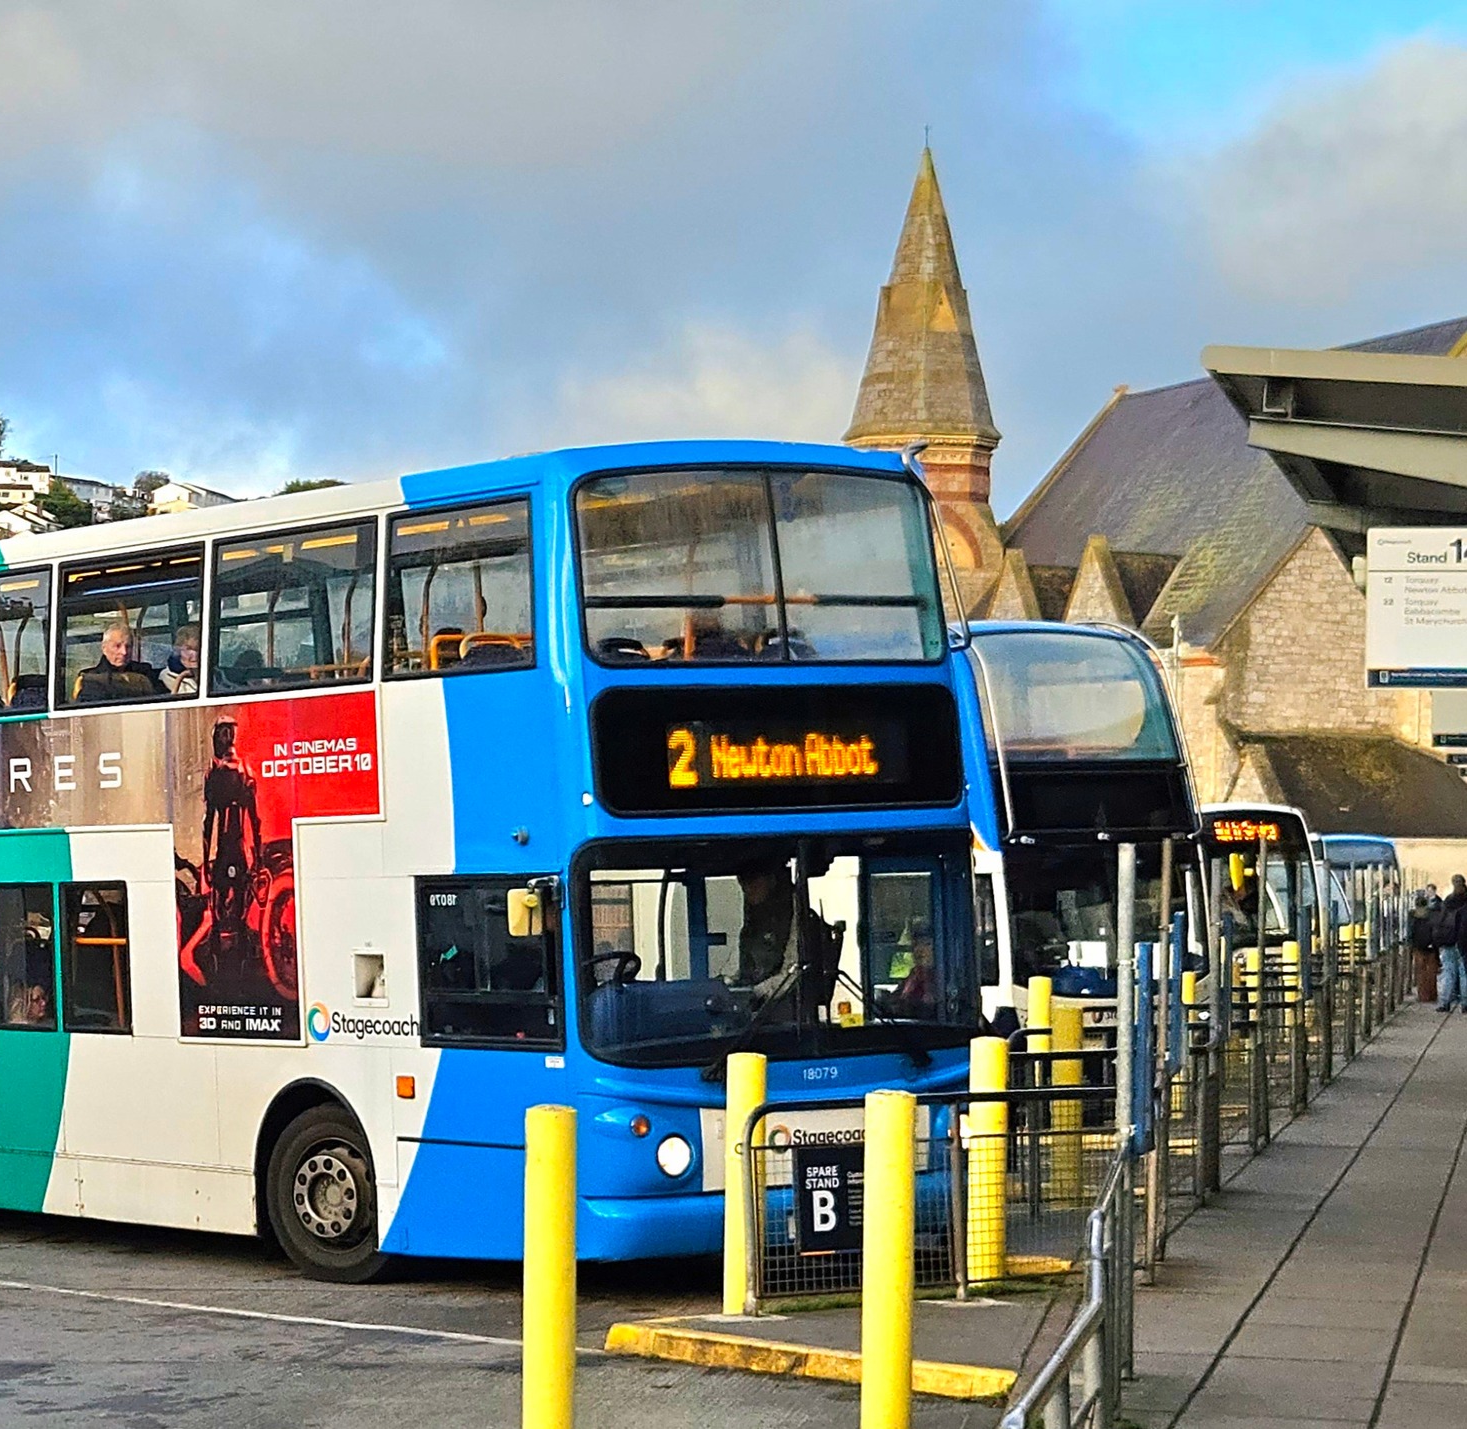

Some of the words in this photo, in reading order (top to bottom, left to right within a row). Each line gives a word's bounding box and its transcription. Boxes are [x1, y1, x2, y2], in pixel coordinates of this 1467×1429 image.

[1406, 551, 1448, 564] Stand
[274, 742, 288, 757] IN
[292, 737, 357, 754] CINEMAS
[261, 754, 352, 778] OCTOBER
[354, 753, 372, 771] 10
[667, 728, 699, 789] 2
[710, 734, 802, 779] Newton
[805, 732, 879, 776] Abbot
[198, 1004, 256, 1016] EXPERIENCE
[259, 1005, 269, 1016] IT
[272, 1006, 282, 1016] IN
[198, 1017, 217, 1030] 3D
[221, 1019, 242, 1031] AND
[245, 1018, 282, 1032] IMAX
[331, 1011, 420, 1040] Stagecoach
[803, 1066, 839, 1080] 18079
[793, 1128, 865, 1145] Stagecoa
[806, 1164, 838, 1177] SPARE
[805, 1177, 840, 1190] STAND
[812, 1189, 837, 1232] B
